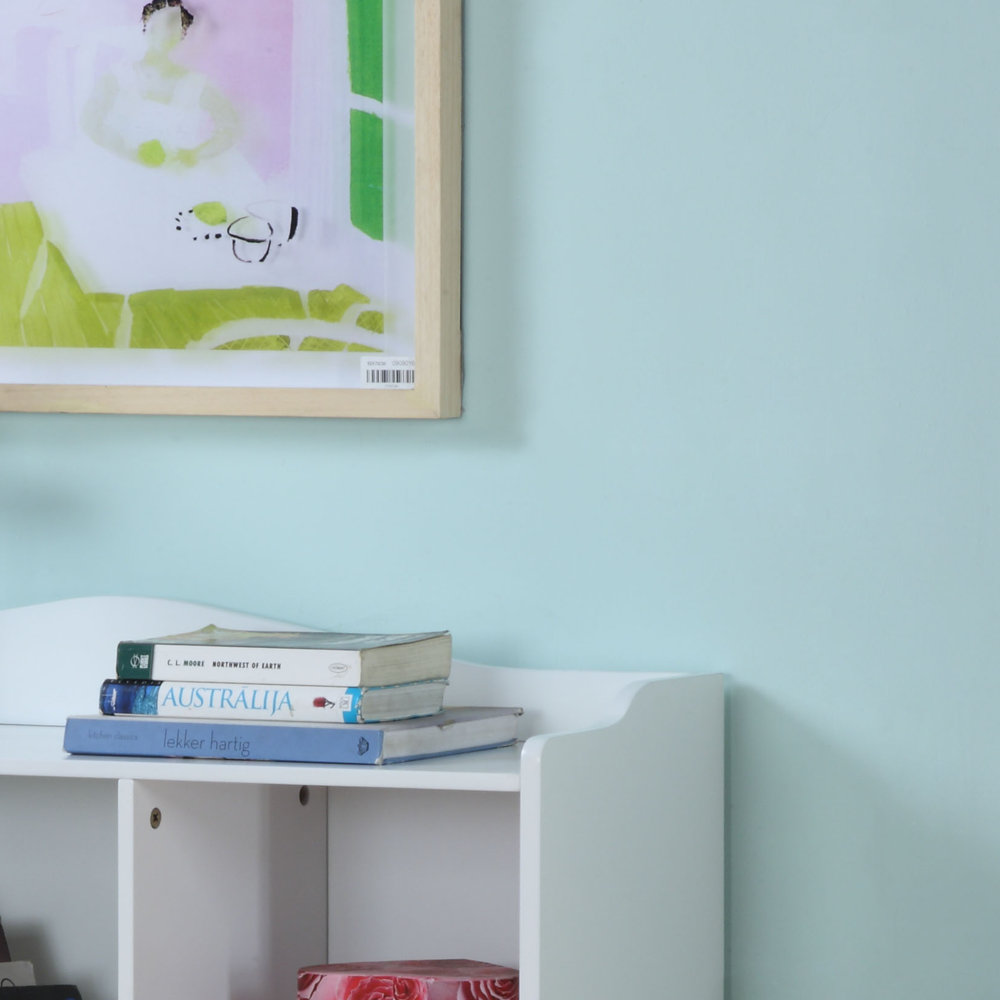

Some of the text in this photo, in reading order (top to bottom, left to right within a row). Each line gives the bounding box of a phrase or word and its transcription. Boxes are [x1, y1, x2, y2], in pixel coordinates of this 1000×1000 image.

[212, 661, 249, 669] NORTHWEST
[261, 662, 282, 670] EARTH
[163, 728, 250, 758] lekker hartig
